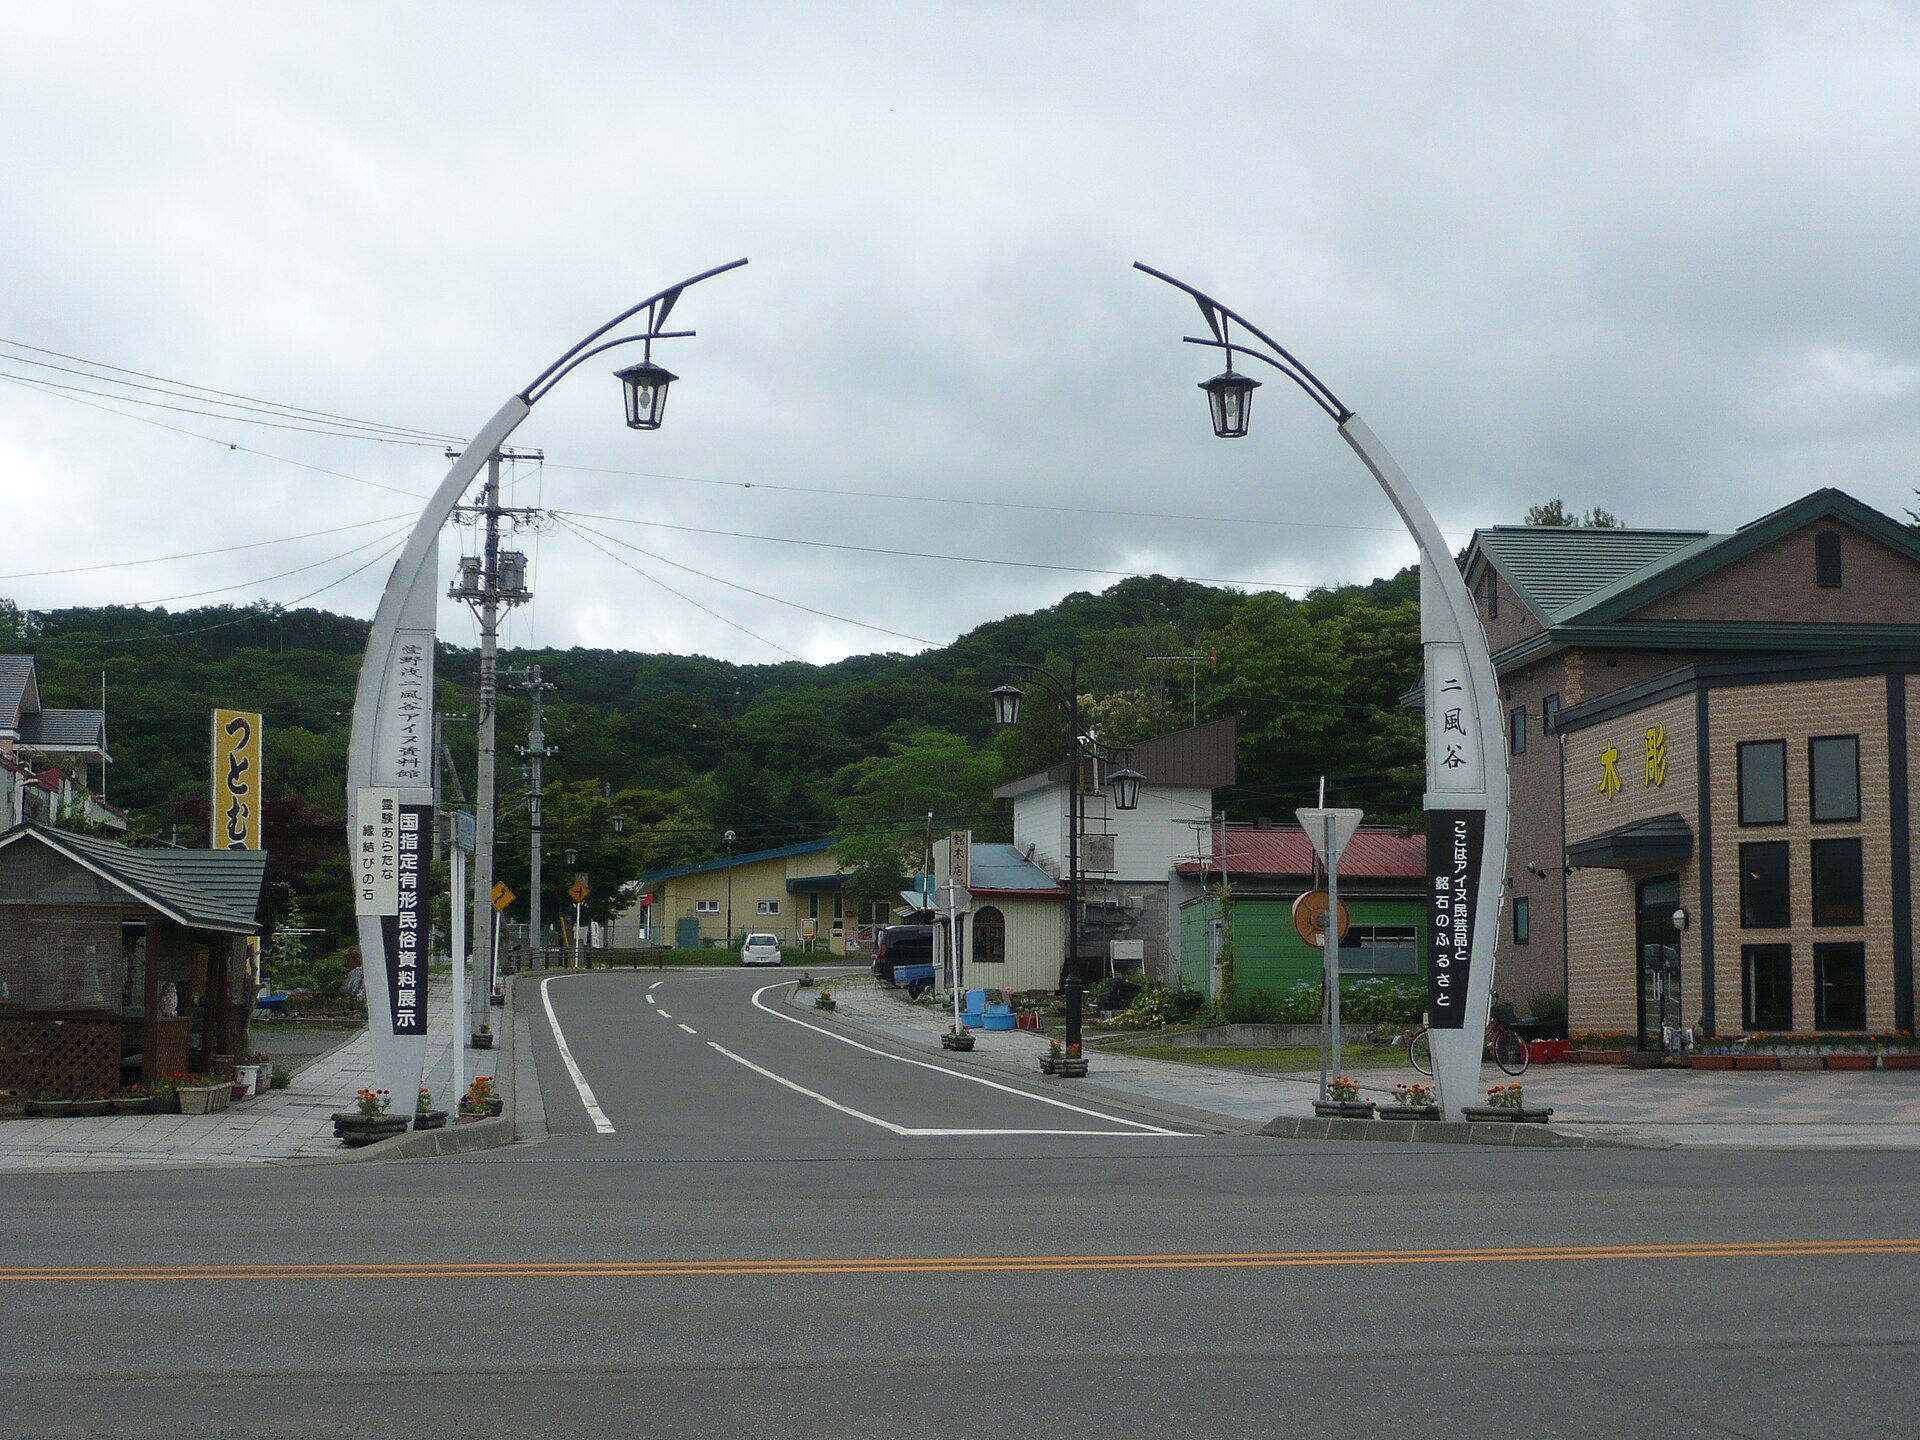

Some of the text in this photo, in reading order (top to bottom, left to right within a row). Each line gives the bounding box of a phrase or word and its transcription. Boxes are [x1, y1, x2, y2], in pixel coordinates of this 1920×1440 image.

[1440, 678, 1467, 770] 二風谷
[1599, 722, 1667, 801] 木彫
[225, 717, 251, 849] つとむ
[380, 798, 394, 880] 霊験あらたな
[362, 824, 375, 901] 縁結びの石
[1453, 820, 1468, 961] ここはアイヌ民芸品と
[397, 812, 419, 1027] 国指定有形民俗資料展示
[1435, 875, 1450, 1007] 銘石のふるさと
